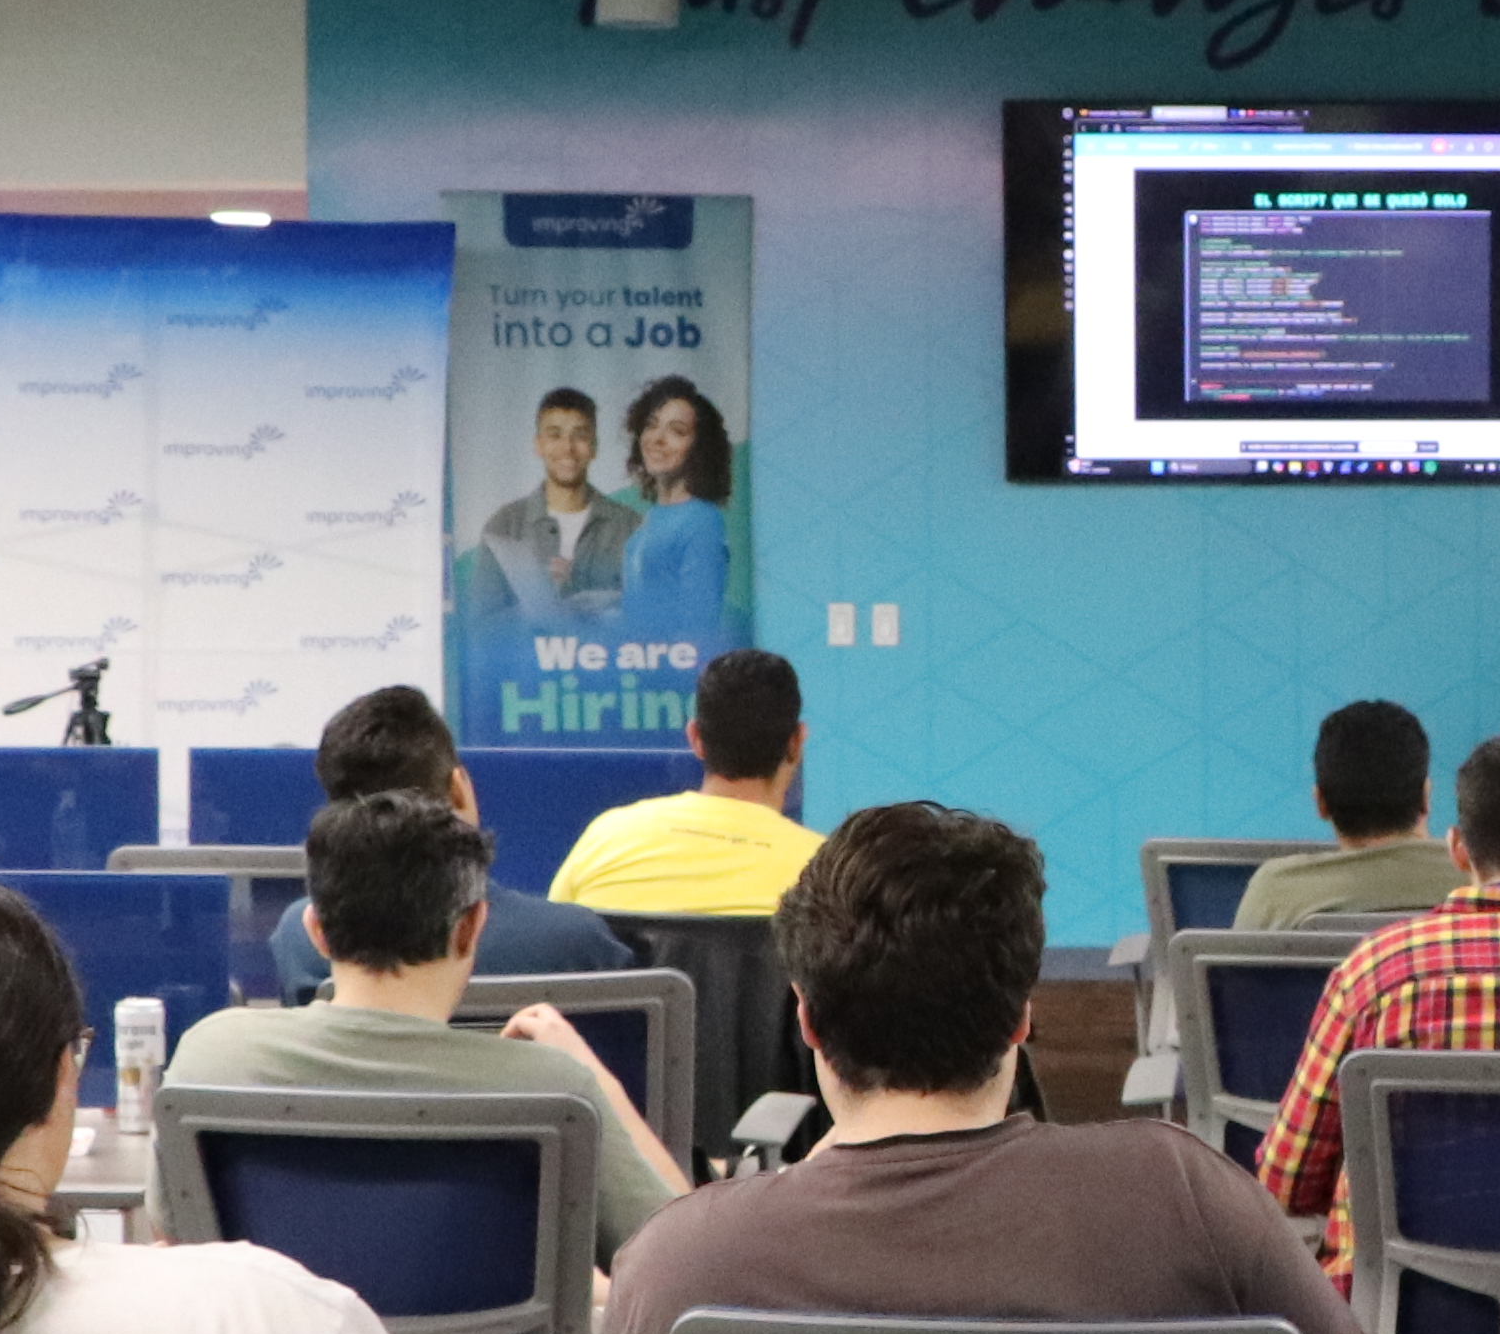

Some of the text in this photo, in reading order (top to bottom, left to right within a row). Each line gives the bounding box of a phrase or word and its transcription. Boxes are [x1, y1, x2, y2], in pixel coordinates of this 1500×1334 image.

[1331, 192, 1359, 210] QUE
[490, 284, 704, 312] Turn your talent
[494, 314, 702, 349] into a Job
[534, 635, 698, 671] We are
[501, 673, 697, 734] Hirin
